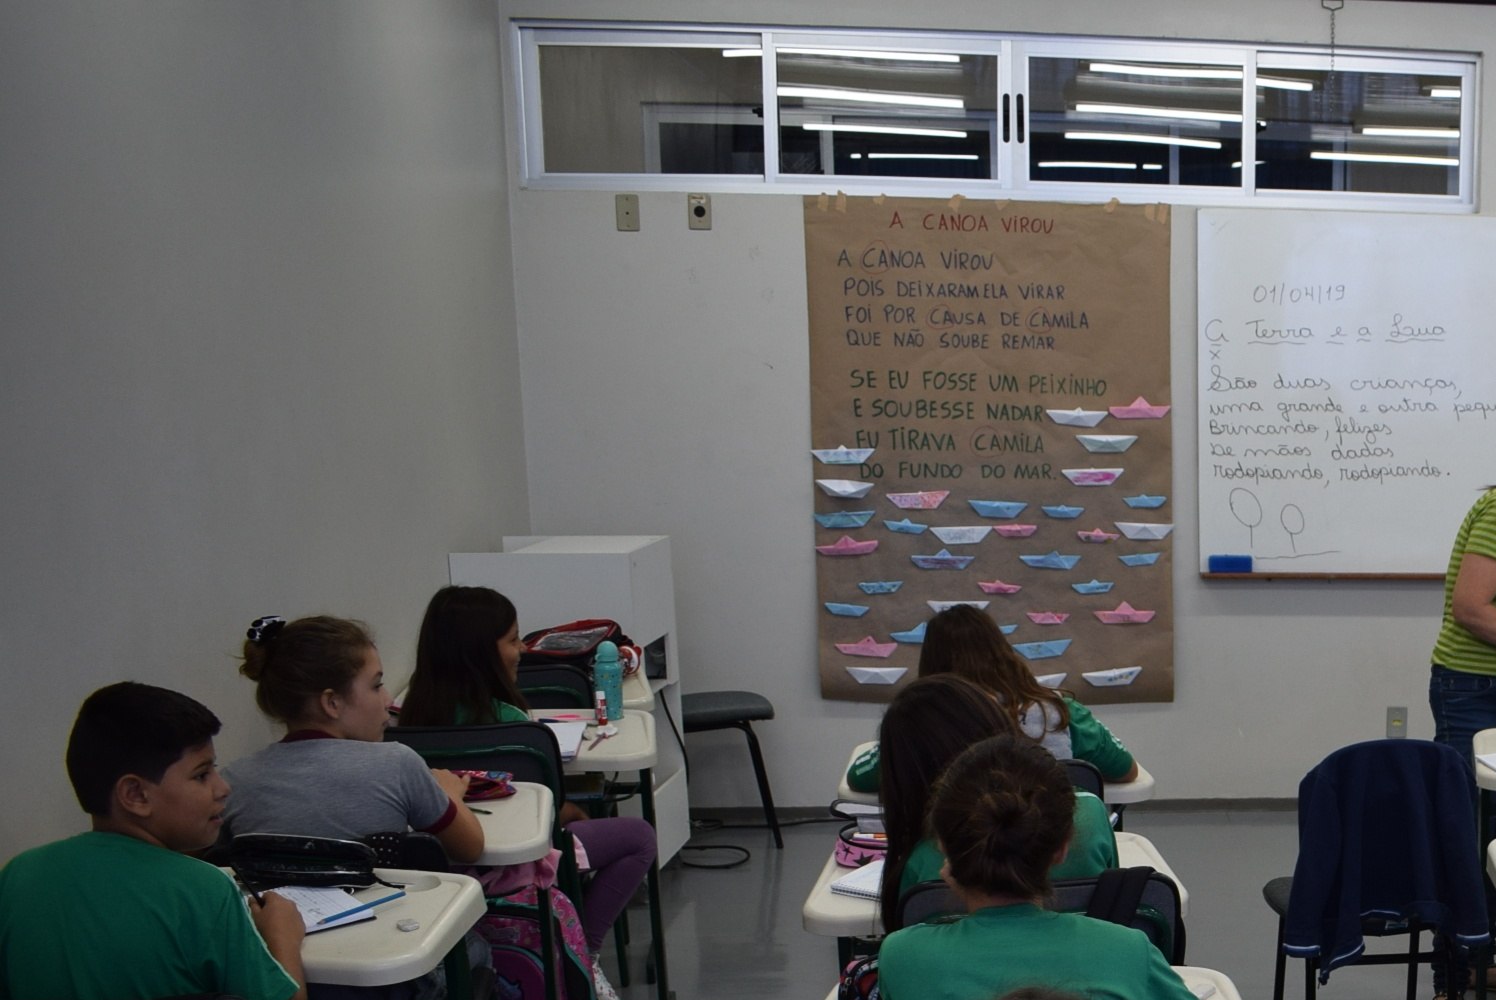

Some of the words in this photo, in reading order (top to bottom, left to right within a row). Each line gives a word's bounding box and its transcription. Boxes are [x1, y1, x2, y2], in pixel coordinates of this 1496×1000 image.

[889, 211, 904, 229] A
[923, 214, 988, 231] CANOA
[1002, 216, 1054, 234] VIROU
[837, 249, 851, 267] A
[862, 248, 926, 268] CANOA
[940, 249, 994, 270] VIROU
[844, 278, 884, 297] POIS
[1018, 284, 1064, 299] VIRAR
[1253, 282, 1346, 306] 01/04/19
[845, 304, 872, 324] FOI
[883, 306, 915, 324] POR
[929, 308, 986, 326] CAUSA
[1000, 311, 1020, 326] DE
[1029, 311, 1089, 329] CAMILA
[1245, 320, 1314, 338] Terra
[1326, 325, 1347, 338] e
[1358, 326, 1372, 336] a
[1389, 313, 1446, 338] Lua
[846, 331, 881, 347] QUE
[893, 329, 924, 348] NÃO
[940, 333, 990, 349] SOUBE
[1002, 334, 1055, 350] REMAR
[850, 369, 876, 388] SE
[889, 370, 908, 389] EU
[923, 371, 977, 391] FOSSE
[989, 374, 1019, 393] UM
[1029, 375, 1107, 396] PEIXINHO
[1207, 364, 1258, 392] São
[1273, 374, 1331, 390] duas
[1350, 377, 1463, 399] crianças,
[854, 398, 863, 417] E
[872, 399, 975, 419] SOUBESSE
[987, 402, 1044, 422] NADAR
[1209, 401, 1264, 416] uma
[1277, 398, 1343, 422] grande
[1359, 405, 1368, 413] e
[1378, 398, 1439, 413] outra
[857, 429, 880, 449] EU
[887, 427, 957, 451] TIRAVA
[974, 432, 1045, 453] CAMILA
[1335, 417, 1392, 444] felizes
[1210, 443, 1236, 457] De
[1244, 444, 1311, 457] mãos
[1331, 442, 1394, 460] dadas
[860, 463, 884, 479] DO
[899, 461, 962, 479] FUNDO
[981, 463, 1006, 479] DO
[1014, 463, 1057, 480] MAR.
